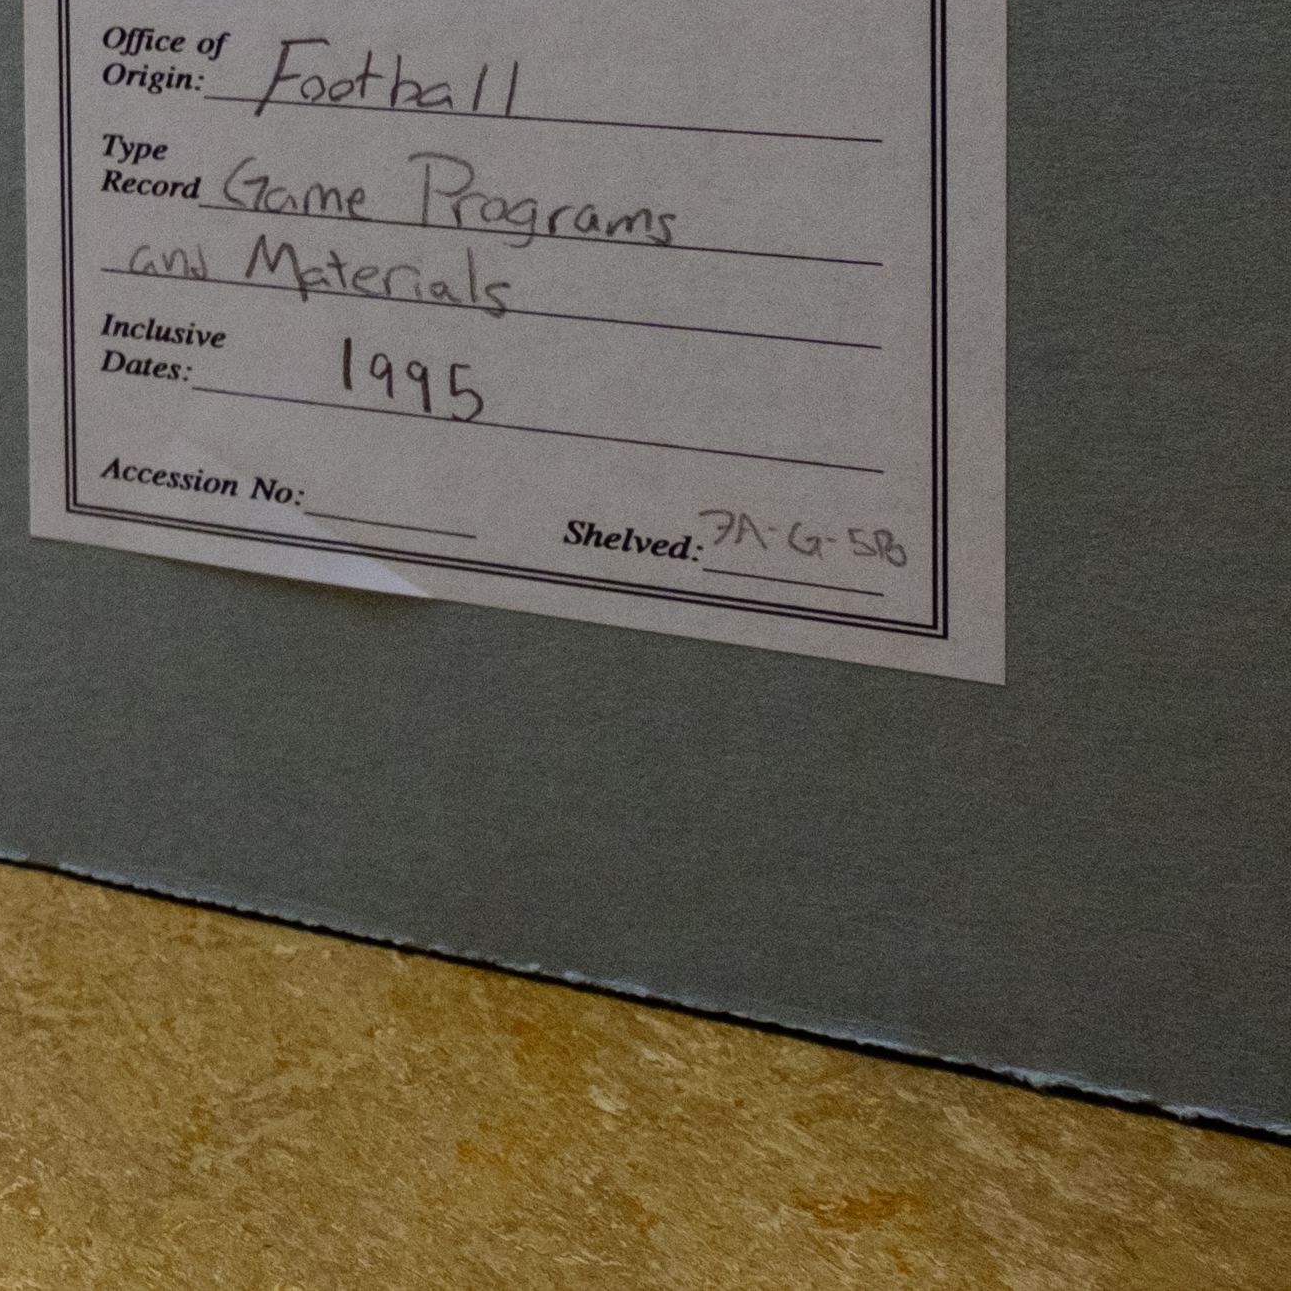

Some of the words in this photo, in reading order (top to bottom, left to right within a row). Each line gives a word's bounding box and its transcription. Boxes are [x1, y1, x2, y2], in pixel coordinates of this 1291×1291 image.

[101, 26, 186, 58] Office
[196, 30, 231, 60] of
[101, 63, 204, 96] Origin:
[255, 38, 519, 116] Football
[101, 134, 168, 165] Type
[101, 171, 200, 200] Record
[222, 157, 367, 216] Game
[409, 151, 677, 247] Programs
[129, 242, 209, 278] and
[246, 235, 511, 317] Materials
[101, 314, 227, 349] Inclusive
[101, 351, 192, 385] Dates:
[342, 337, 485, 422] 1995
[101, 457, 239, 498] Accession
[249, 475, 305, 507] No:
[563, 520, 704, 562] Shelved:
